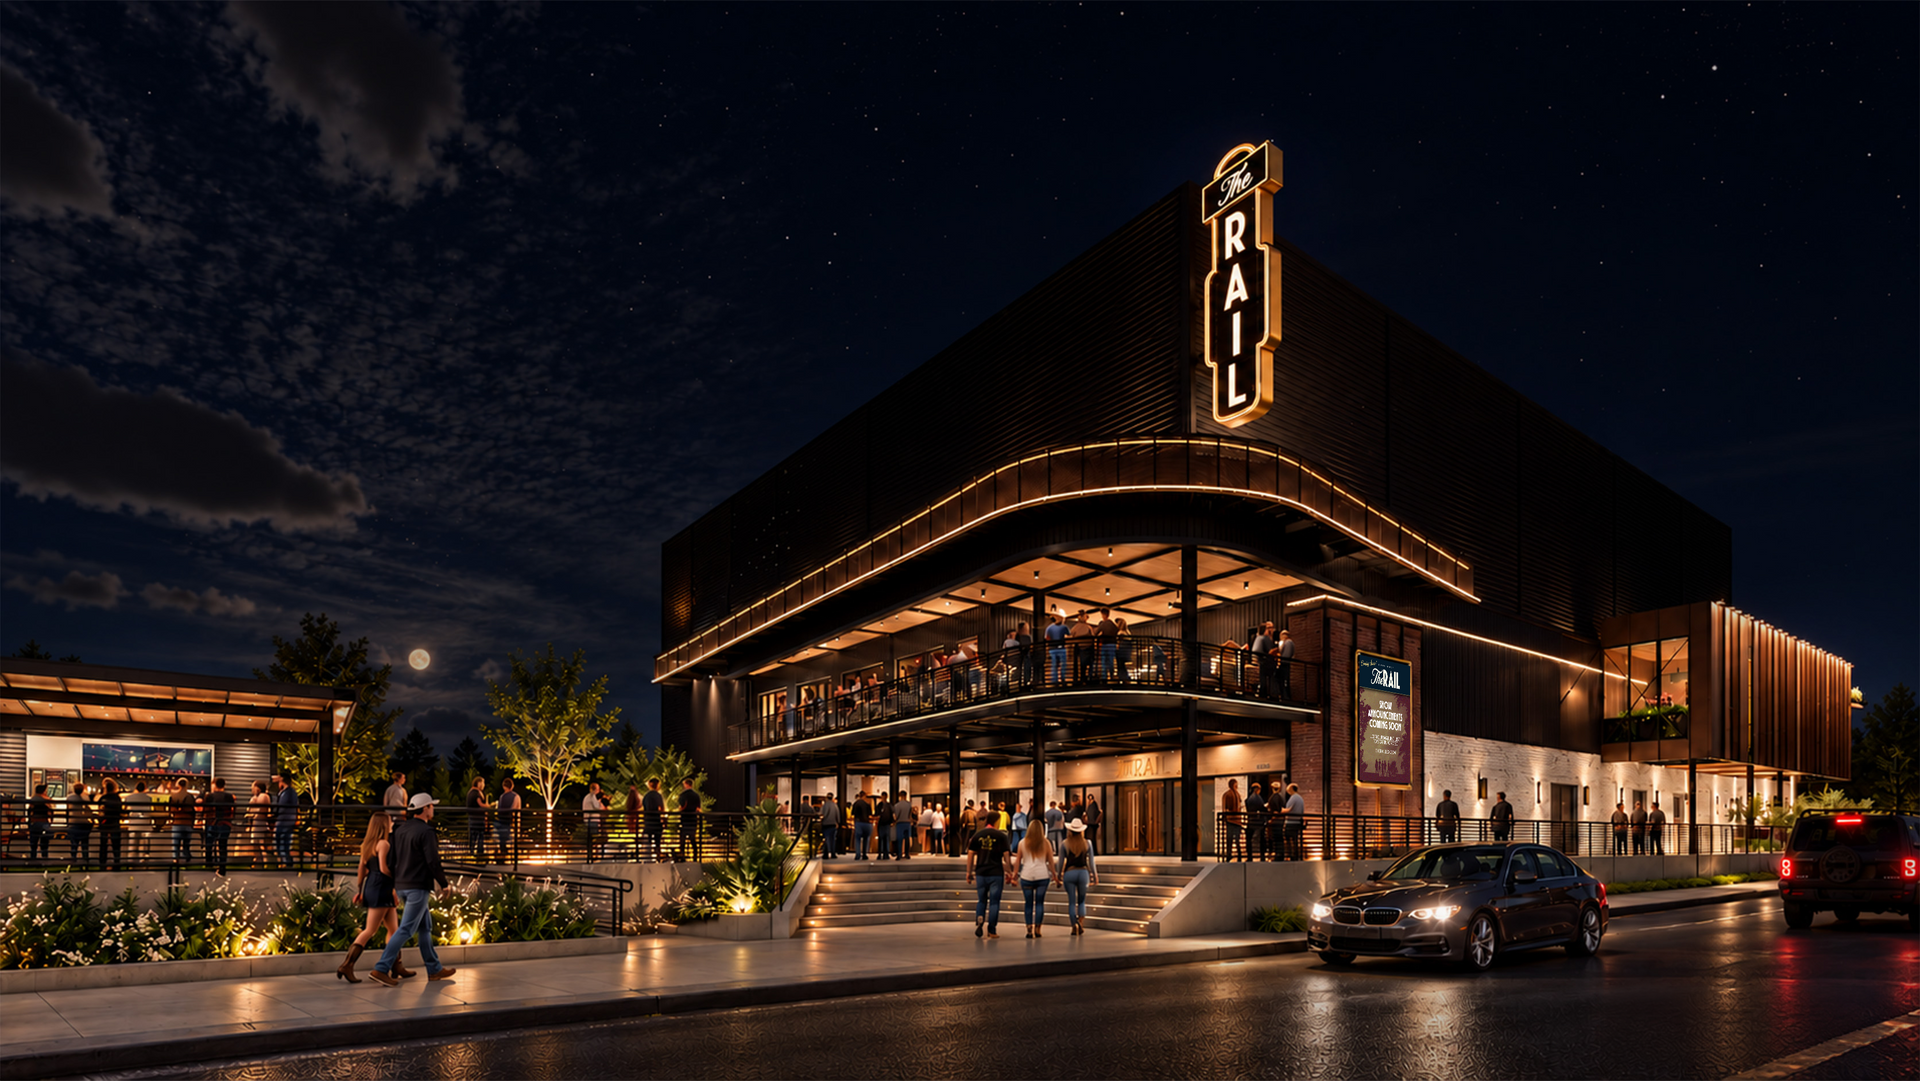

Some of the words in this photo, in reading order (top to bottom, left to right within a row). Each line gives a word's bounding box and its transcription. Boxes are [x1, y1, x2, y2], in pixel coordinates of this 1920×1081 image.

[1217, 161, 1254, 207] The
[1224, 210, 1249, 409] RAIL
[1367, 709, 1403, 722] ANNOUNCEMENTS
[1369, 719, 1388, 730] COMING
[1388, 721, 1402, 731] SOON
